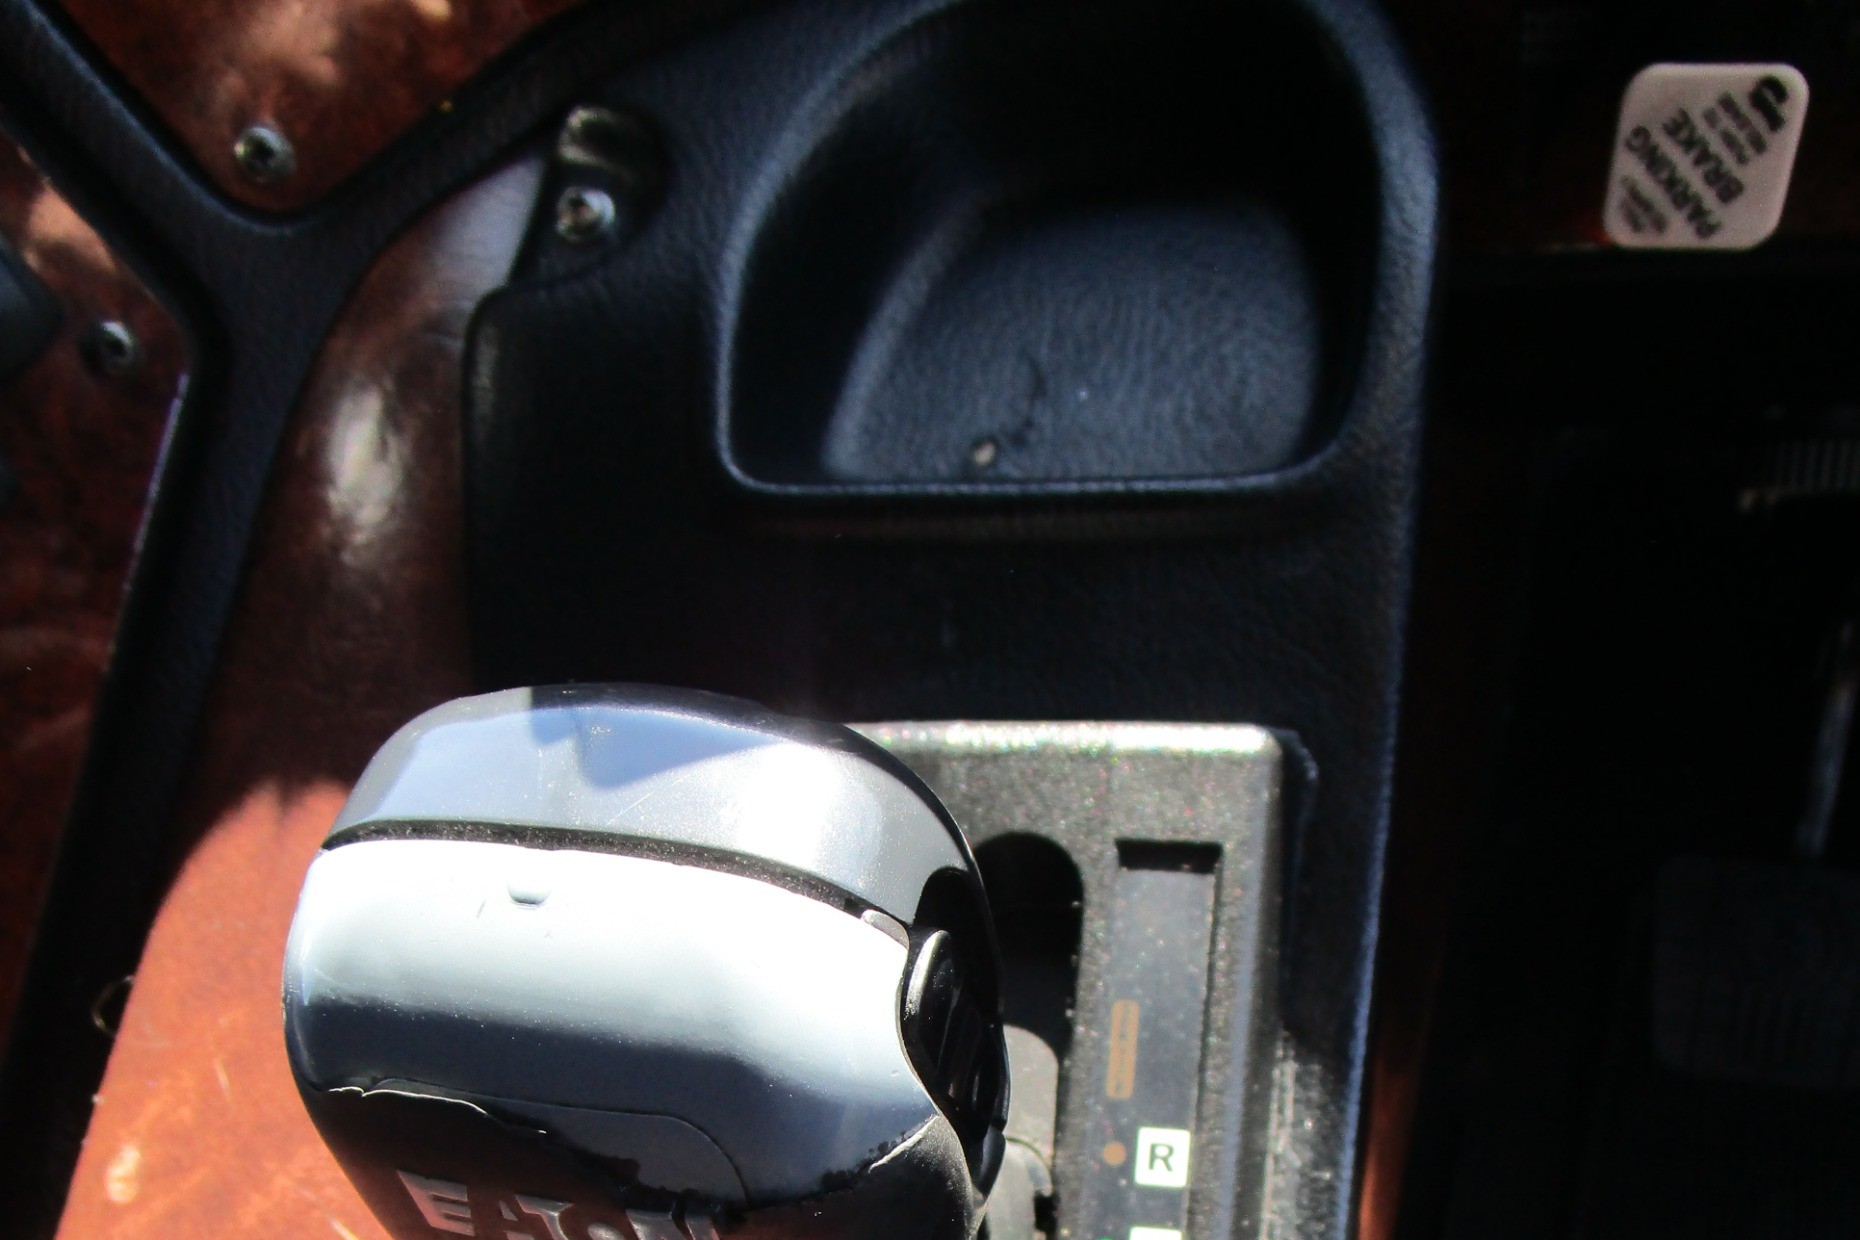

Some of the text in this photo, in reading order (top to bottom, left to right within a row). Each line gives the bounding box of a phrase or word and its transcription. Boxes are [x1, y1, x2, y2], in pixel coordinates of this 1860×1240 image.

[1625, 124, 1722, 240] PARKING
[1662, 107, 1745, 204] BRAKE
[1147, 1142, 1175, 1173] R
